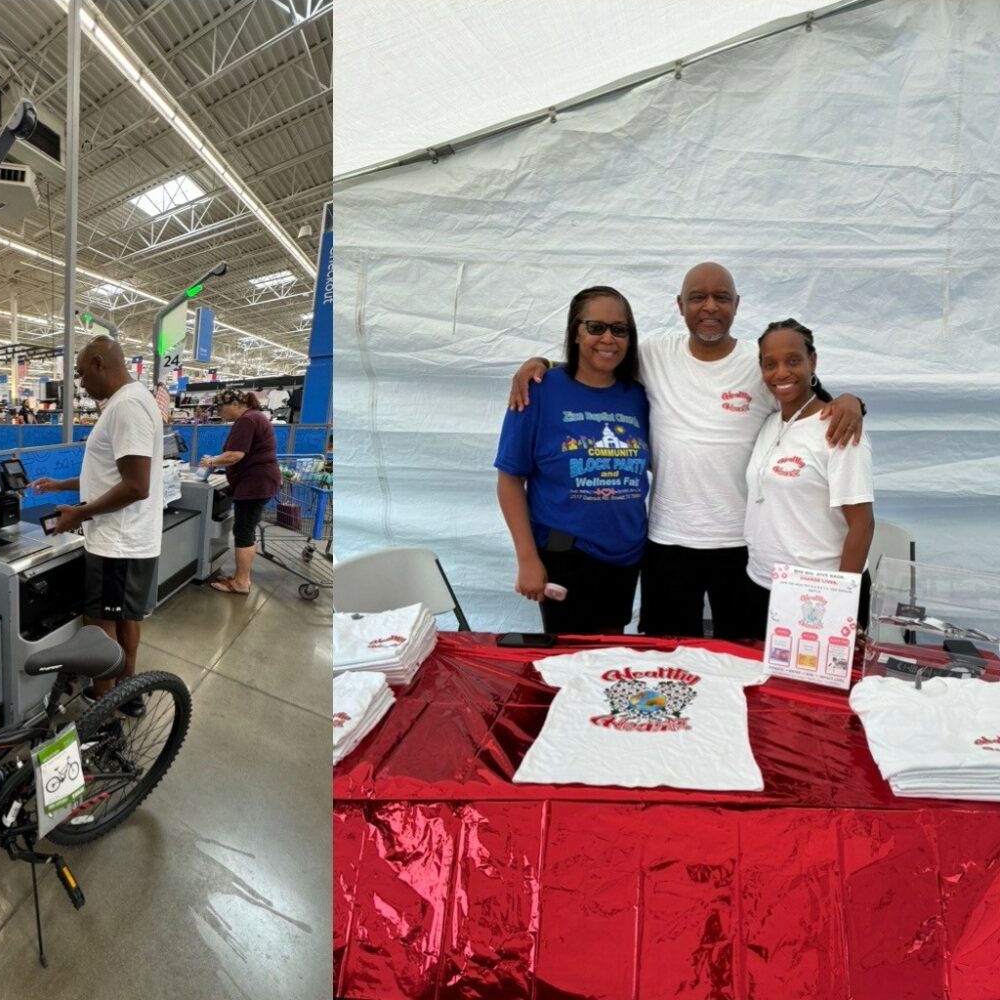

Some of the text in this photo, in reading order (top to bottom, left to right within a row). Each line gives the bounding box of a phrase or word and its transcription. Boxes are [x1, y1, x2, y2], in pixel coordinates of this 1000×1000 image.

[163, 354, 179, 368] 24
[569, 458, 646, 478] BLOCK PARTY
[575, 478, 621, 487] Wellness
[601, 667, 701, 686] Healthy
[590, 715, 692, 732] Hearts
